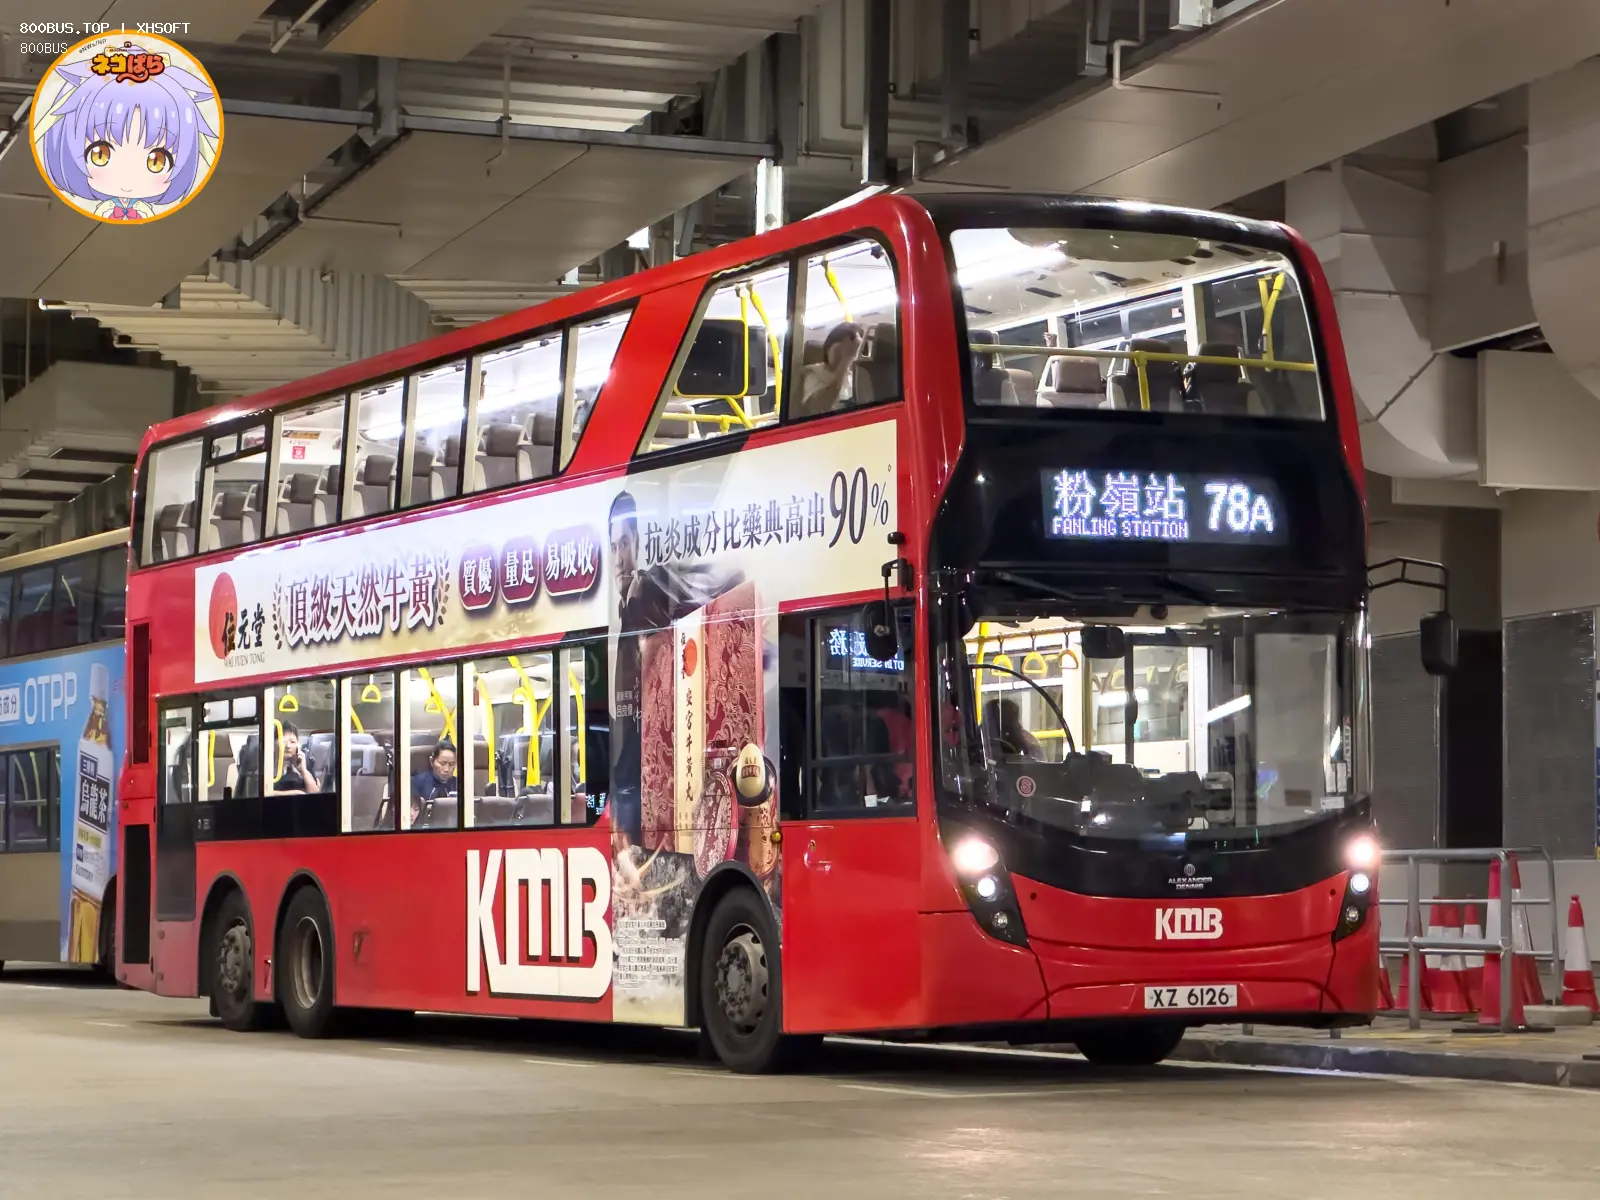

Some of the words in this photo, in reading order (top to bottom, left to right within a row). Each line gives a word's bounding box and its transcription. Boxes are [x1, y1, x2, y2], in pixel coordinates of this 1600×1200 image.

[1053, 469, 1186, 520] 粉嶺站
[1204, 483, 1275, 533] 78A
[1052, 516, 1118, 537] FANLING
[1121, 519, 1189, 539] STATION
[503, 548, 536, 589] 量足
[545, 535, 595, 582] 易吸收
[285, 554, 434, 641] 頂級天然牛黃
[221, 602, 266, 657] 位元堂
[24, 671, 78, 725] OTPP
[465, 846, 613, 1003] KMB
[1155, 907, 1224, 940] KMB
[1153, 989, 1179, 1008] XZ
[1187, 987, 1230, 1006] 6126
